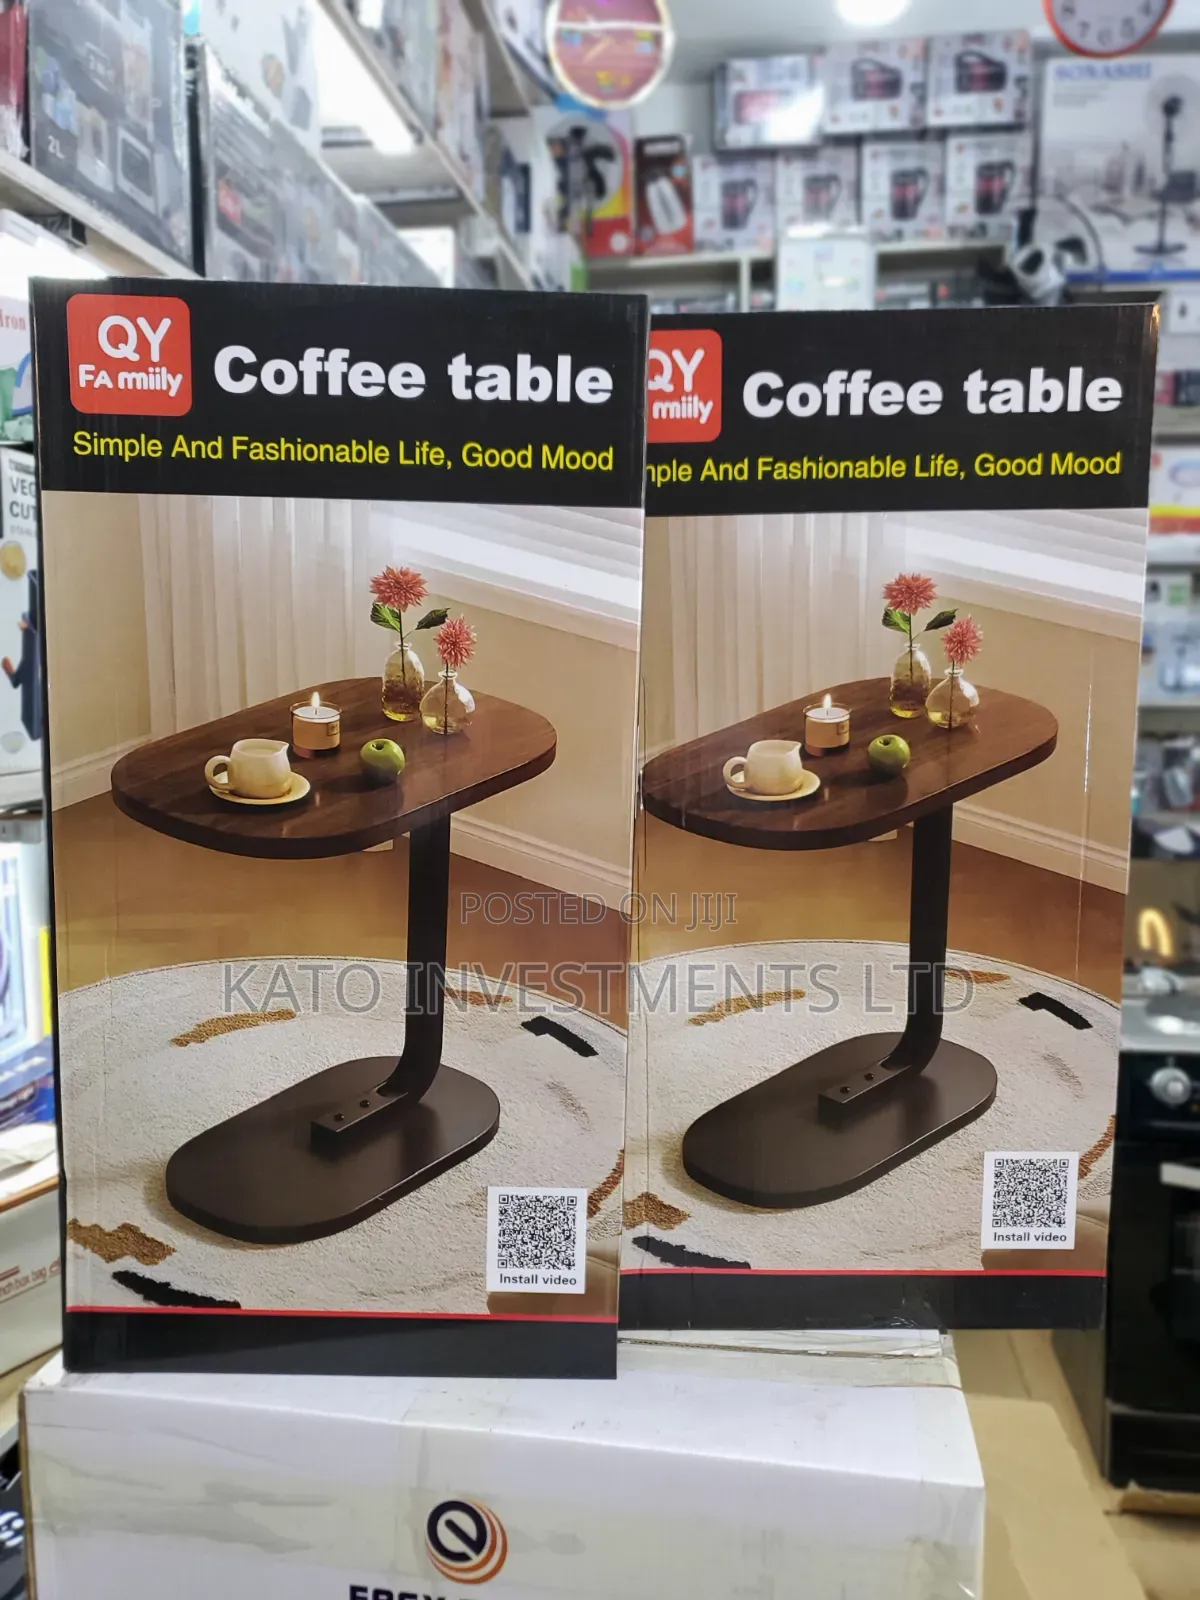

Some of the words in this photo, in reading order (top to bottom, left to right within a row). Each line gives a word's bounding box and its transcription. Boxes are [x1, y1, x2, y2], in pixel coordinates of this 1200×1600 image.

[98, 315, 172, 363] QY
[214, 345, 426, 399] Coffee
[447, 352, 613, 404] table
[742, 369, 943, 418] Coffee
[963, 366, 1123, 415] table
[73, 430, 163, 462] Simple
[171, 434, 223, 460] And
[232, 436, 390, 464] Fashionable
[399, 440, 452, 470] Life,
[462, 441, 533, 469] Good
[541, 444, 614, 471] Mood
[699, 458, 749, 482] And
[757, 455, 907, 481] Fashionable
[914, 453, 966, 480] Life,
[974, 453, 1043, 477] Good
[1050, 451, 1122, 476] Mood
[994, 1232, 1030, 1242] Install
[1034, 1232, 1067, 1242] video
[499, 1273, 538, 1284] Install
[542, 1274, 577, 1285] video
